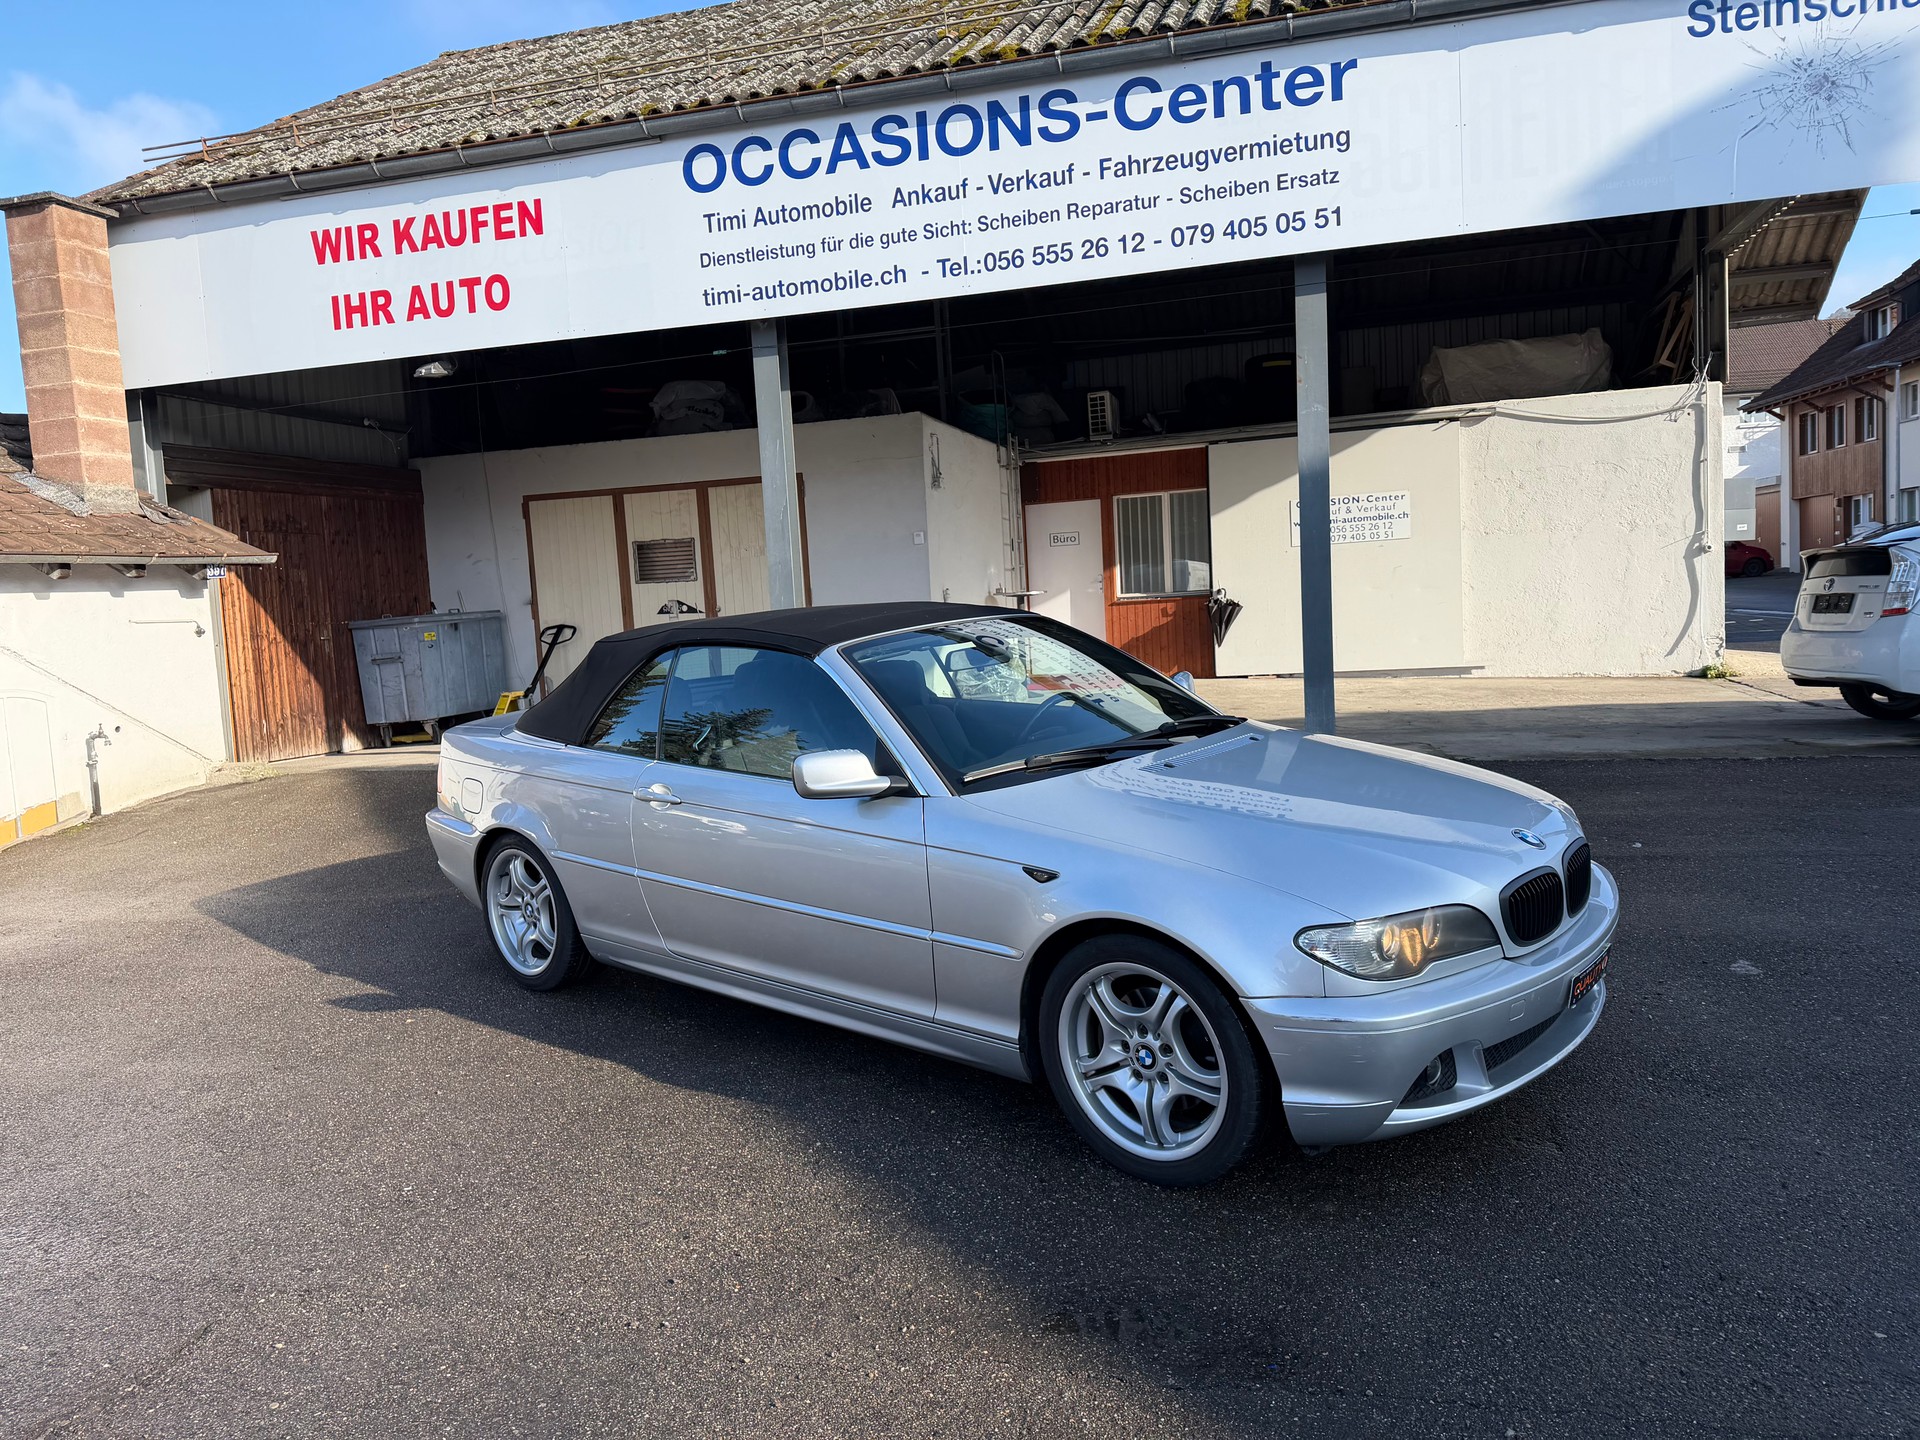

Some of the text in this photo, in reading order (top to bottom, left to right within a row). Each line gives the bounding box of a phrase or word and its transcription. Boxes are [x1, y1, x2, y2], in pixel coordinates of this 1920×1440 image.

[1687, 0, 1920, 37] Steinsc
[682, 58, 1358, 193] OCCASIONS-Center
[703, 209, 747, 233] Timi
[753, 193, 873, 227] Automobile
[891, 178, 969, 209] Ankauf
[1099, 129, 1351, 180] Fahrzeugvermietung
[310, 223, 383, 265] WIR
[392, 198, 544, 255] KAUFEN
[700, 240, 816, 268] Dienstleistung
[820, 236, 845, 254] für
[849, 232, 875, 250] die
[880, 227, 918, 249] gute
[923, 219, 973, 240] Sicht:
[977, 208, 1060, 233] Scheiben
[1066, 195, 1160, 221] Reparatur
[1179, 178, 1270, 205] Scheiben
[1276, 169, 1340, 191] Ersatz
[702, 265, 907, 307] timi-automobile.ch
[1031, 242, 1074, 266] 555
[1081, 237, 1109, 260] 26
[1118, 232, 1145, 256] 12
[1170, 222, 1215, 248] 079
[1222, 215, 1268, 241] 405
[1275, 210, 1306, 234] 05
[1314, 205, 1342, 229] 51
[331, 273, 511, 330] IHR AUTO
[1349, 523, 1366, 532] 555
[1368, 522, 1380, 531] 26
[1383, 521, 1394, 529] 12
[1350, 532, 1366, 541] 405
[1369, 531, 1381, 540] 05
[1384, 530, 1394, 538] 51
[1356, 502, 1397, 513] Verkauf
[1052, 534, 1077, 544] Büro
